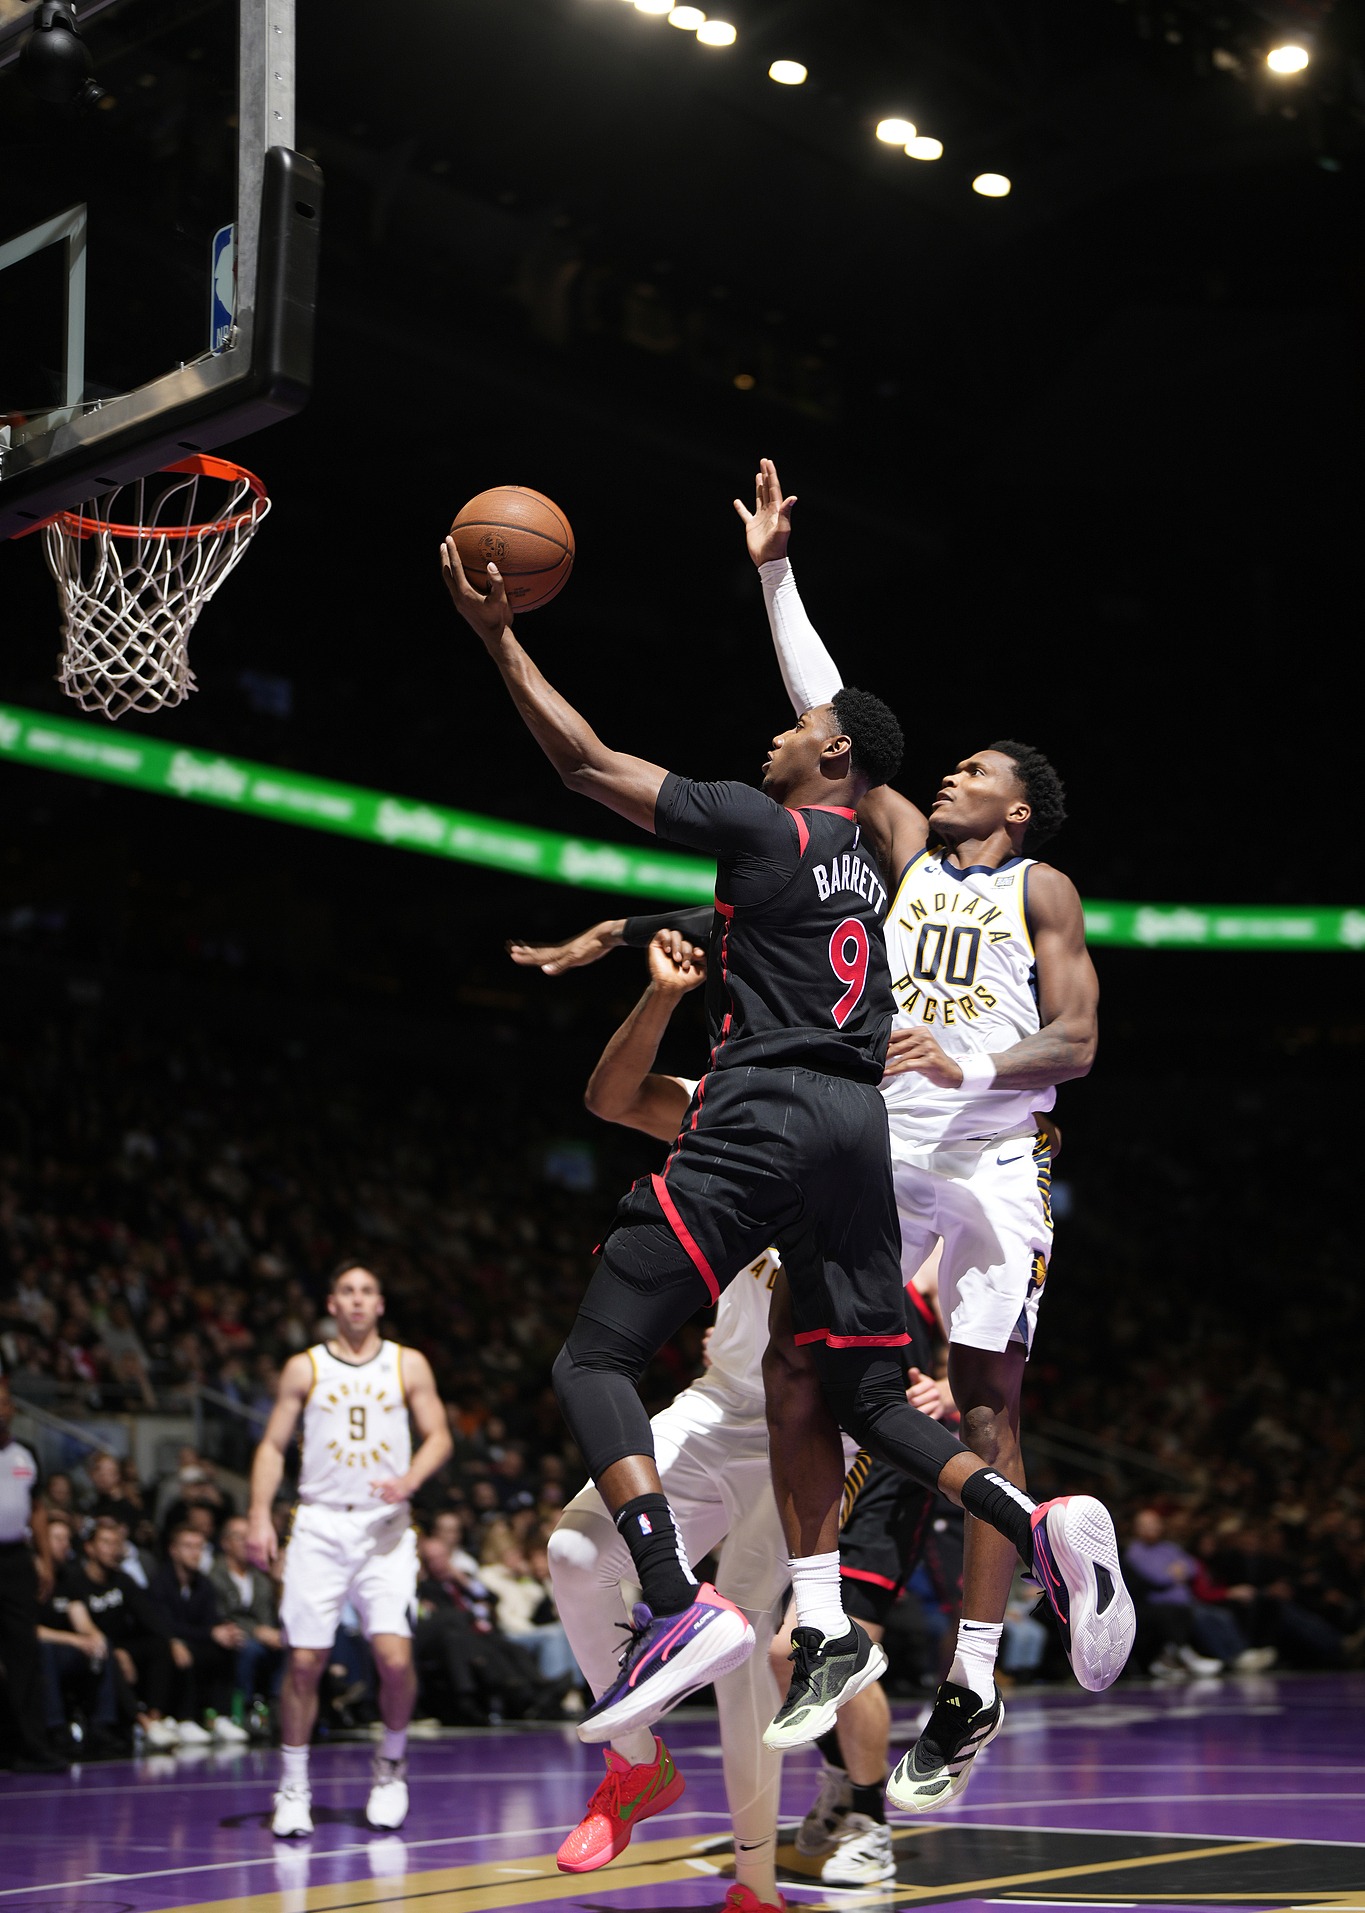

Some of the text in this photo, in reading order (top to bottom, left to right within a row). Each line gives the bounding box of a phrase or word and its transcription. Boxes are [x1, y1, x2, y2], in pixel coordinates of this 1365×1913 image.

[812, 854, 887, 914] BARRETT
[899, 892, 1012, 944] INDIANA
[828, 917, 870, 1030] 9
[913, 923, 982, 987] 00
[891, 973, 998, 1026] PACERS
[349, 1406, 366, 1441] 9
